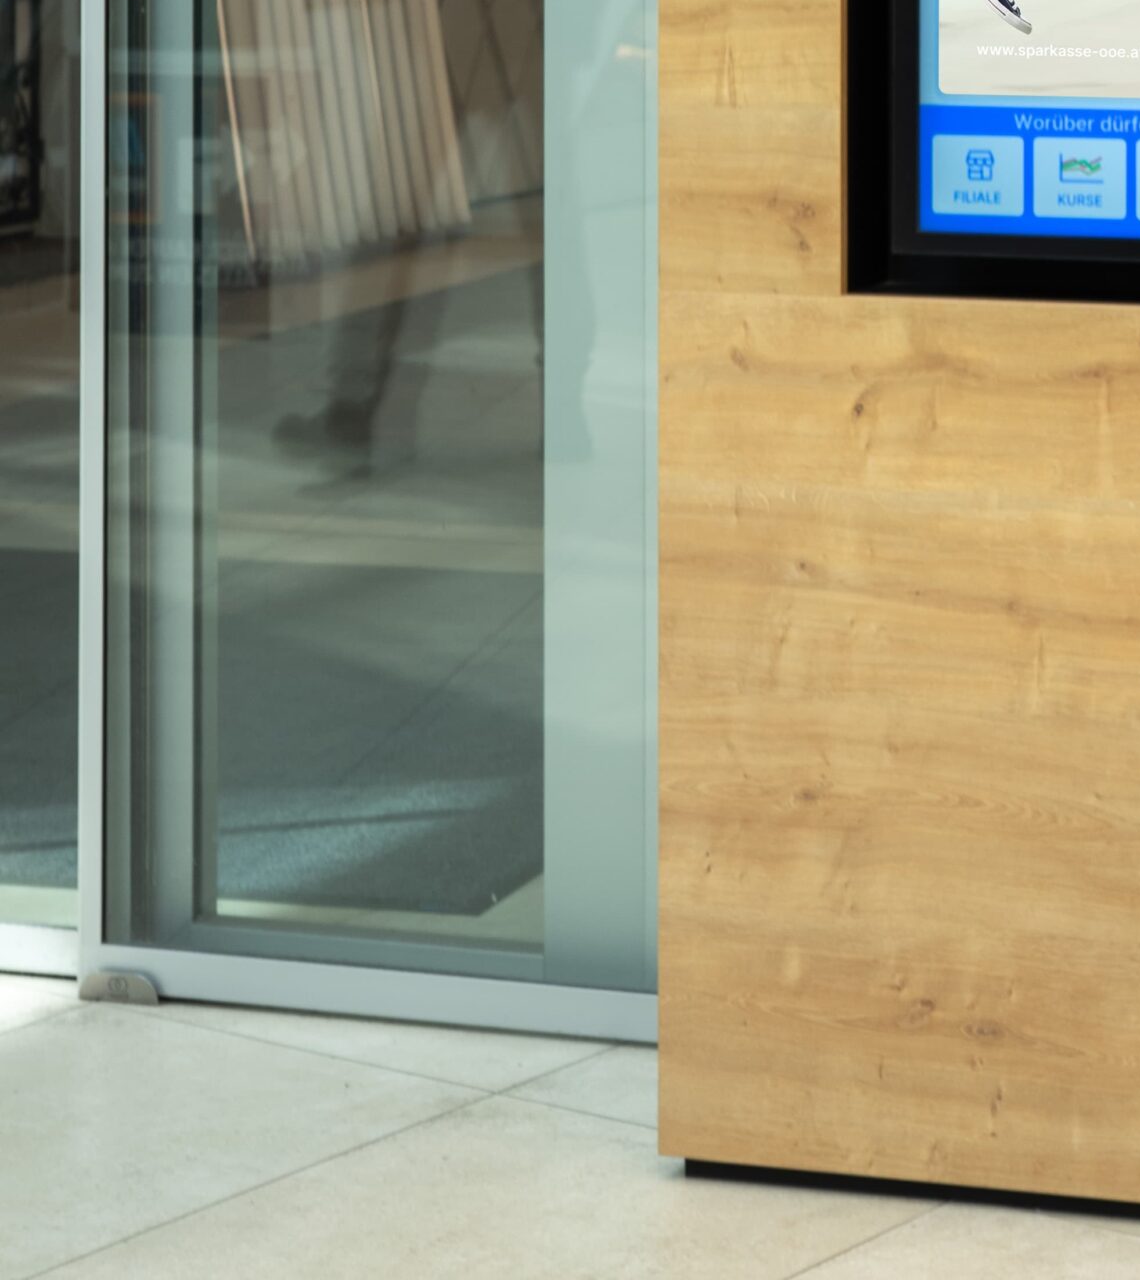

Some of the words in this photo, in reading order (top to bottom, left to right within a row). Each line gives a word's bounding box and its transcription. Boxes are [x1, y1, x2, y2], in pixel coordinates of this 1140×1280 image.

[1014, 112, 1093, 132] Worüber
[953, 190, 1001, 205] FILIALE
[1057, 193, 1103, 208] KURSE
